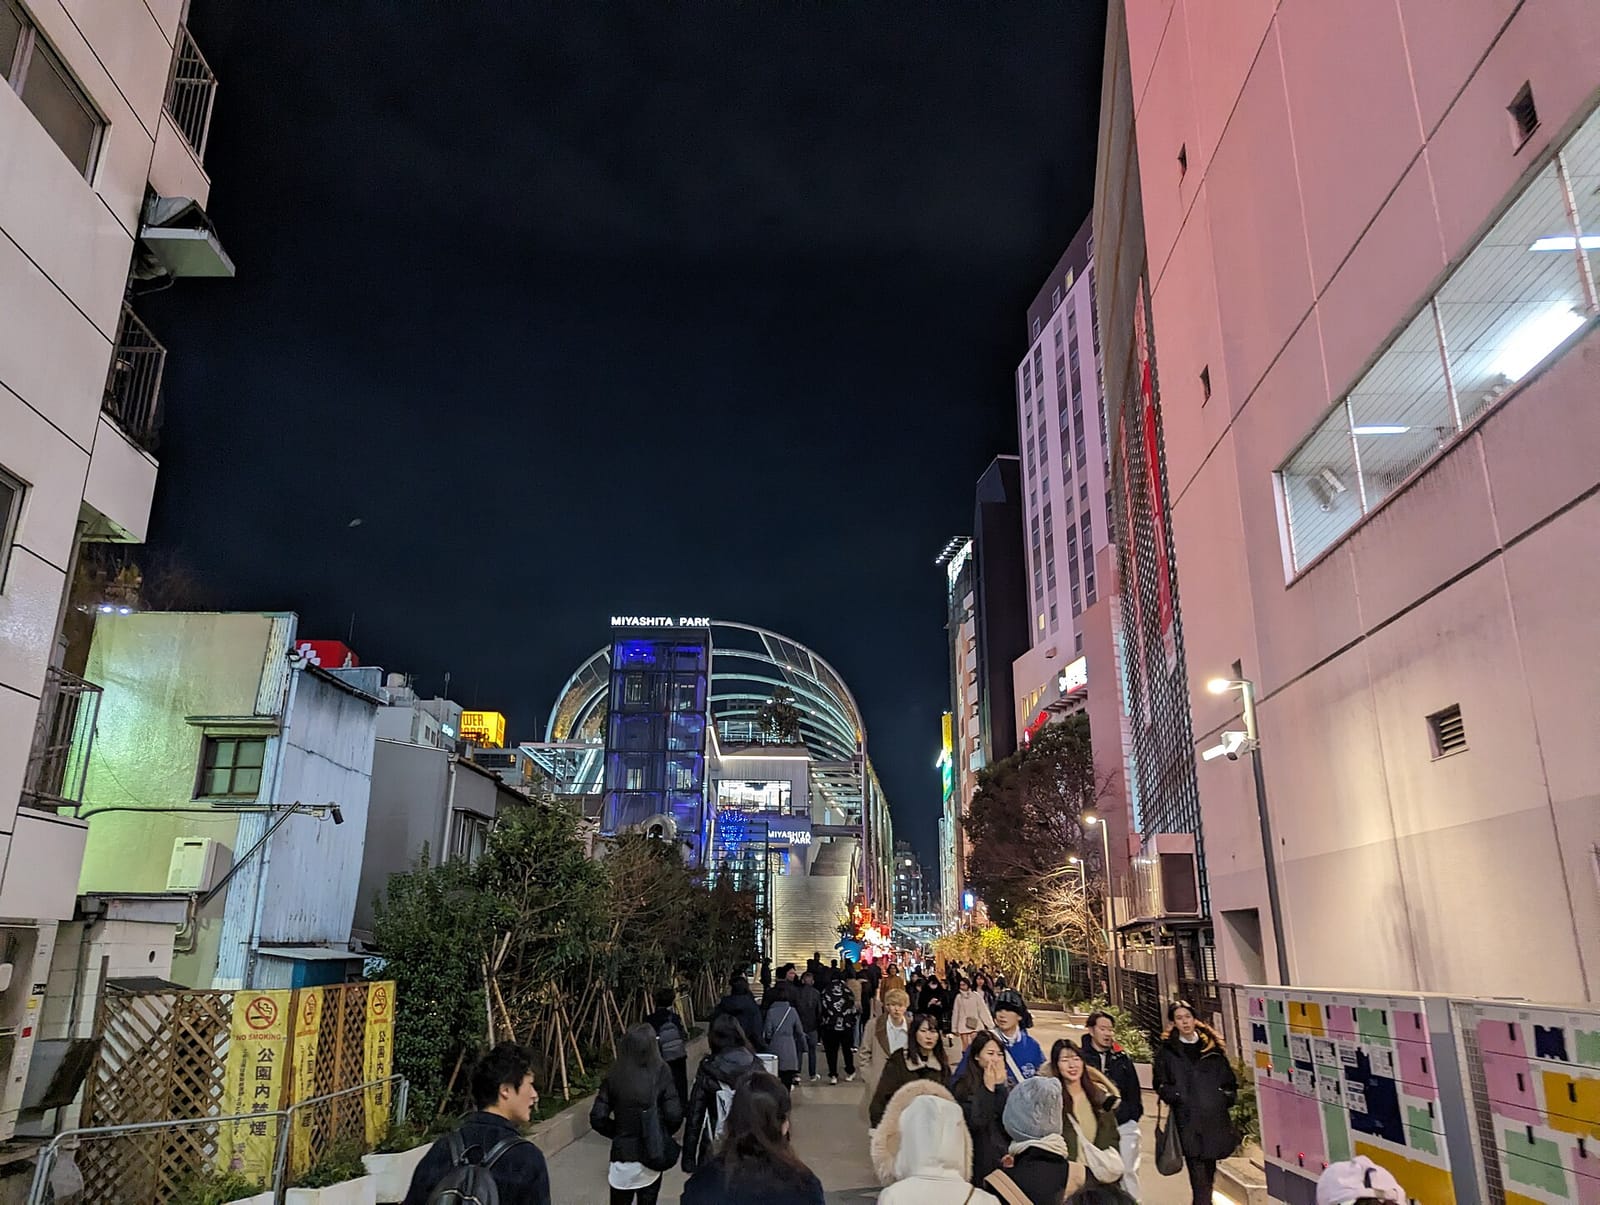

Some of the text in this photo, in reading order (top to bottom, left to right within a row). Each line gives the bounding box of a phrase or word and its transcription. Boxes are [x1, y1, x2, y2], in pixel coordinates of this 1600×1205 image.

[611, 616, 710, 627] MIYASHITA PARK
[768, 830, 811, 839] MIYASHITA
[790, 836, 811, 844] PARK
[249, 1033, 281, 1041] SMOKING
[249, 1047, 275, 1136] 公園内禁煙
